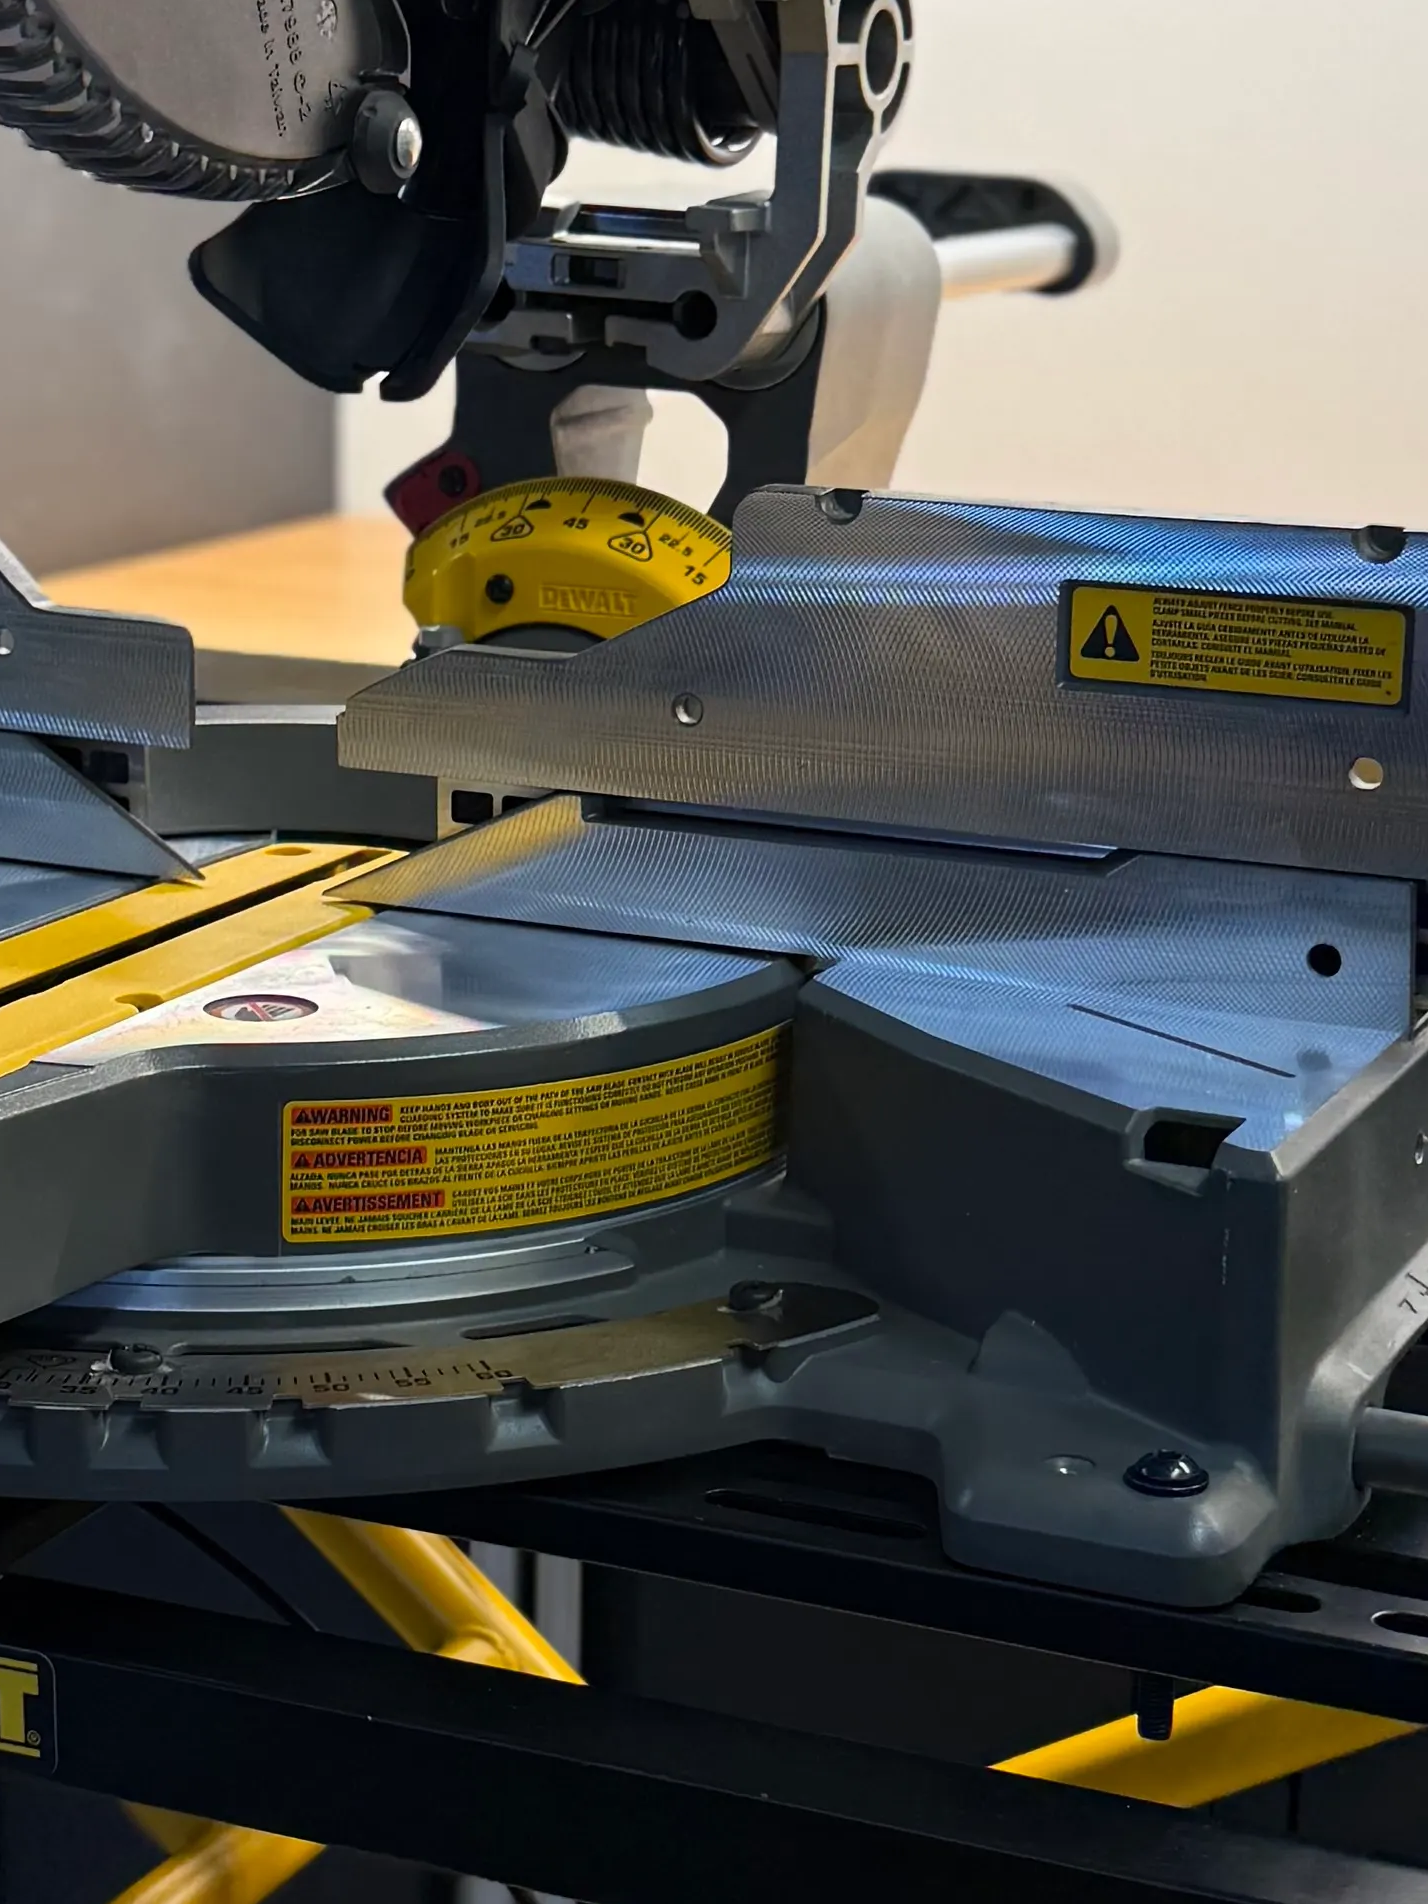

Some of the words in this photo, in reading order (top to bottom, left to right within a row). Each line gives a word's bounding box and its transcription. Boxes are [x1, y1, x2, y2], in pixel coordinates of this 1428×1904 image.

[563, 517, 590, 530] 45
[500, 524, 525, 537] 30
[618, 536, 646, 555] 30
[658, 533, 694, 557] 22.5
[683, 564, 709, 586] 15
[542, 585, 637, 616] DEWALT
[312, 1105, 389, 1124] WARNING
[313, 1148, 422, 1166] ADVERTENCIA
[313, 1191, 438, 1211] AVERTISSEMENT
[476, 1369, 513, 1380] 60
[313, 1383, 350, 1393] 50
[394, 1377, 433, 1388] 55
[59, 1384, 99, 1396] 35
[146, 1386, 179, 1396] 40
[225, 1385, 264, 1396] 45
